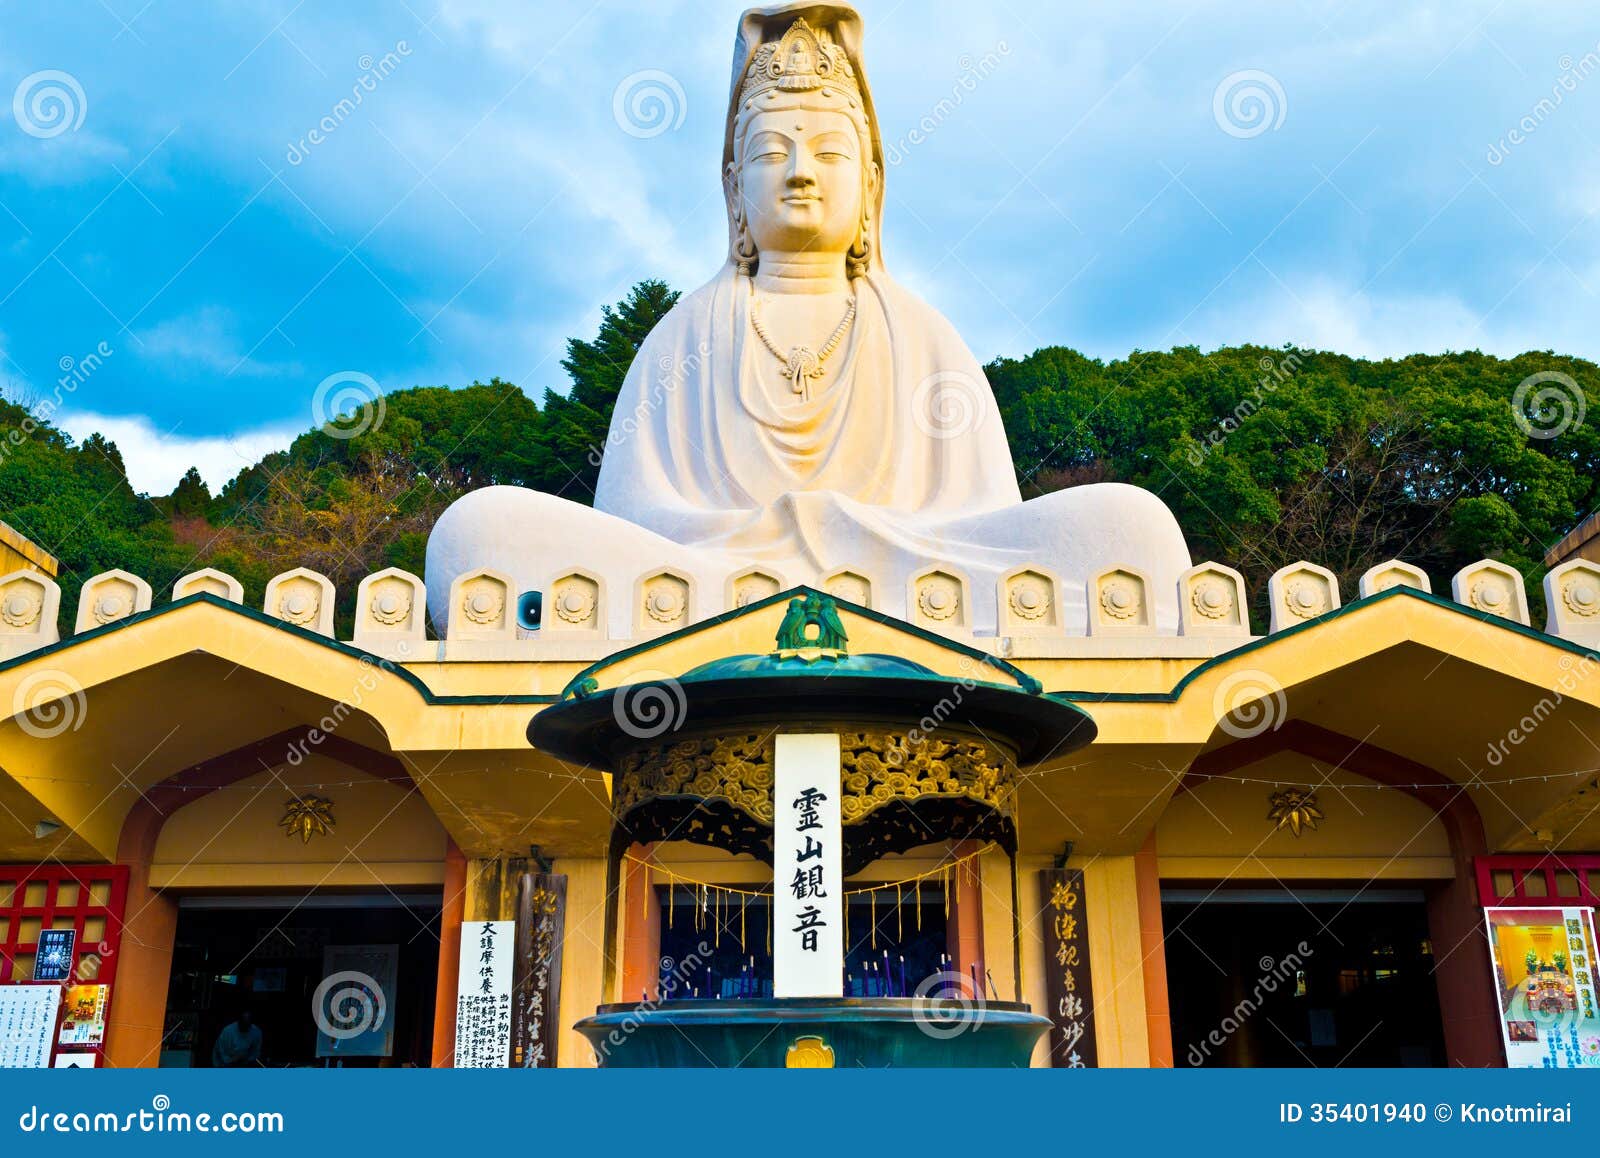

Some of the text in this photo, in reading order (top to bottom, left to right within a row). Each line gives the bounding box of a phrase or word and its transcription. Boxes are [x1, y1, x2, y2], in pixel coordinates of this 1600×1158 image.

[790, 787, 828, 952] 霊山観音
[479, 921, 498, 994] 大護摩供養
